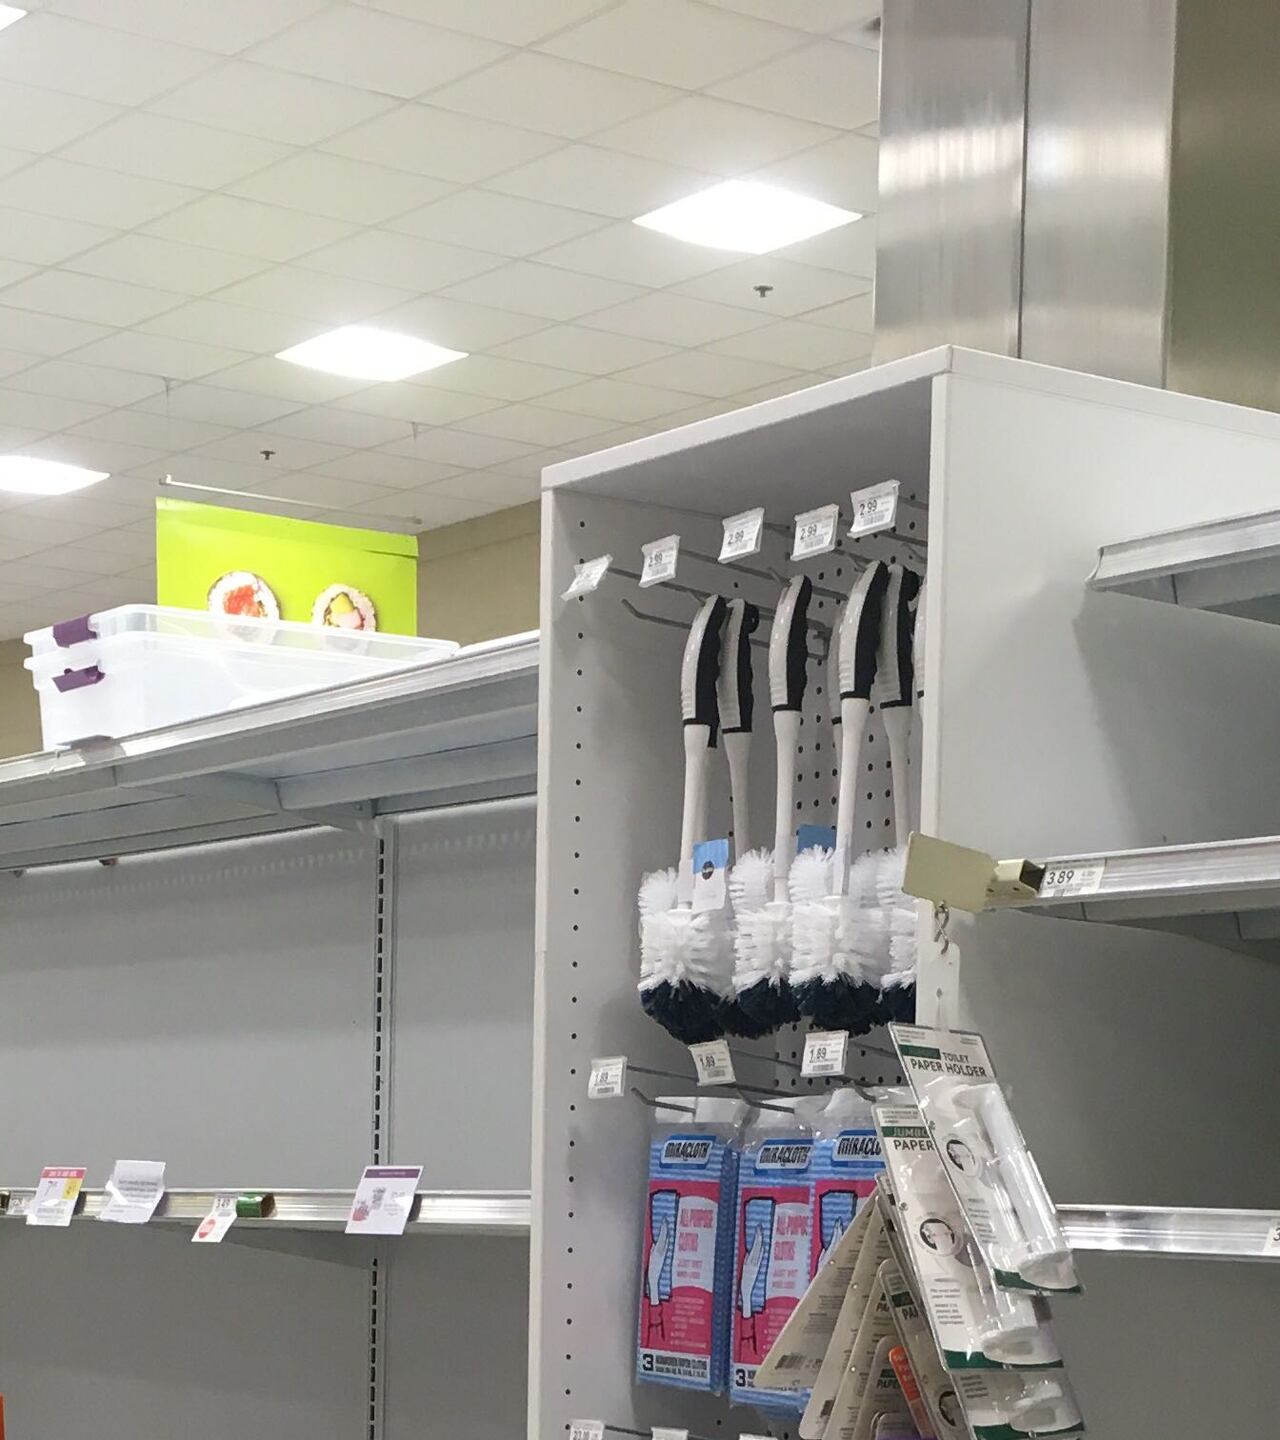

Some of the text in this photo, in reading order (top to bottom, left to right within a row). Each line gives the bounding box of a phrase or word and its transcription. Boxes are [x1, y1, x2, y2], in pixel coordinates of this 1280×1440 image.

[942, 1051, 969, 1063] TOILET
[910, 1058, 987, 1078] PAPER HOLDER
[664, 1140, 710, 1160] MIRACLOTH
[759, 1144, 811, 1164] MIRACLOTH
[893, 1139, 935, 1152] PAPER
[642, 1353, 655, 1372] 3
[735, 1368, 746, 1387] 3
